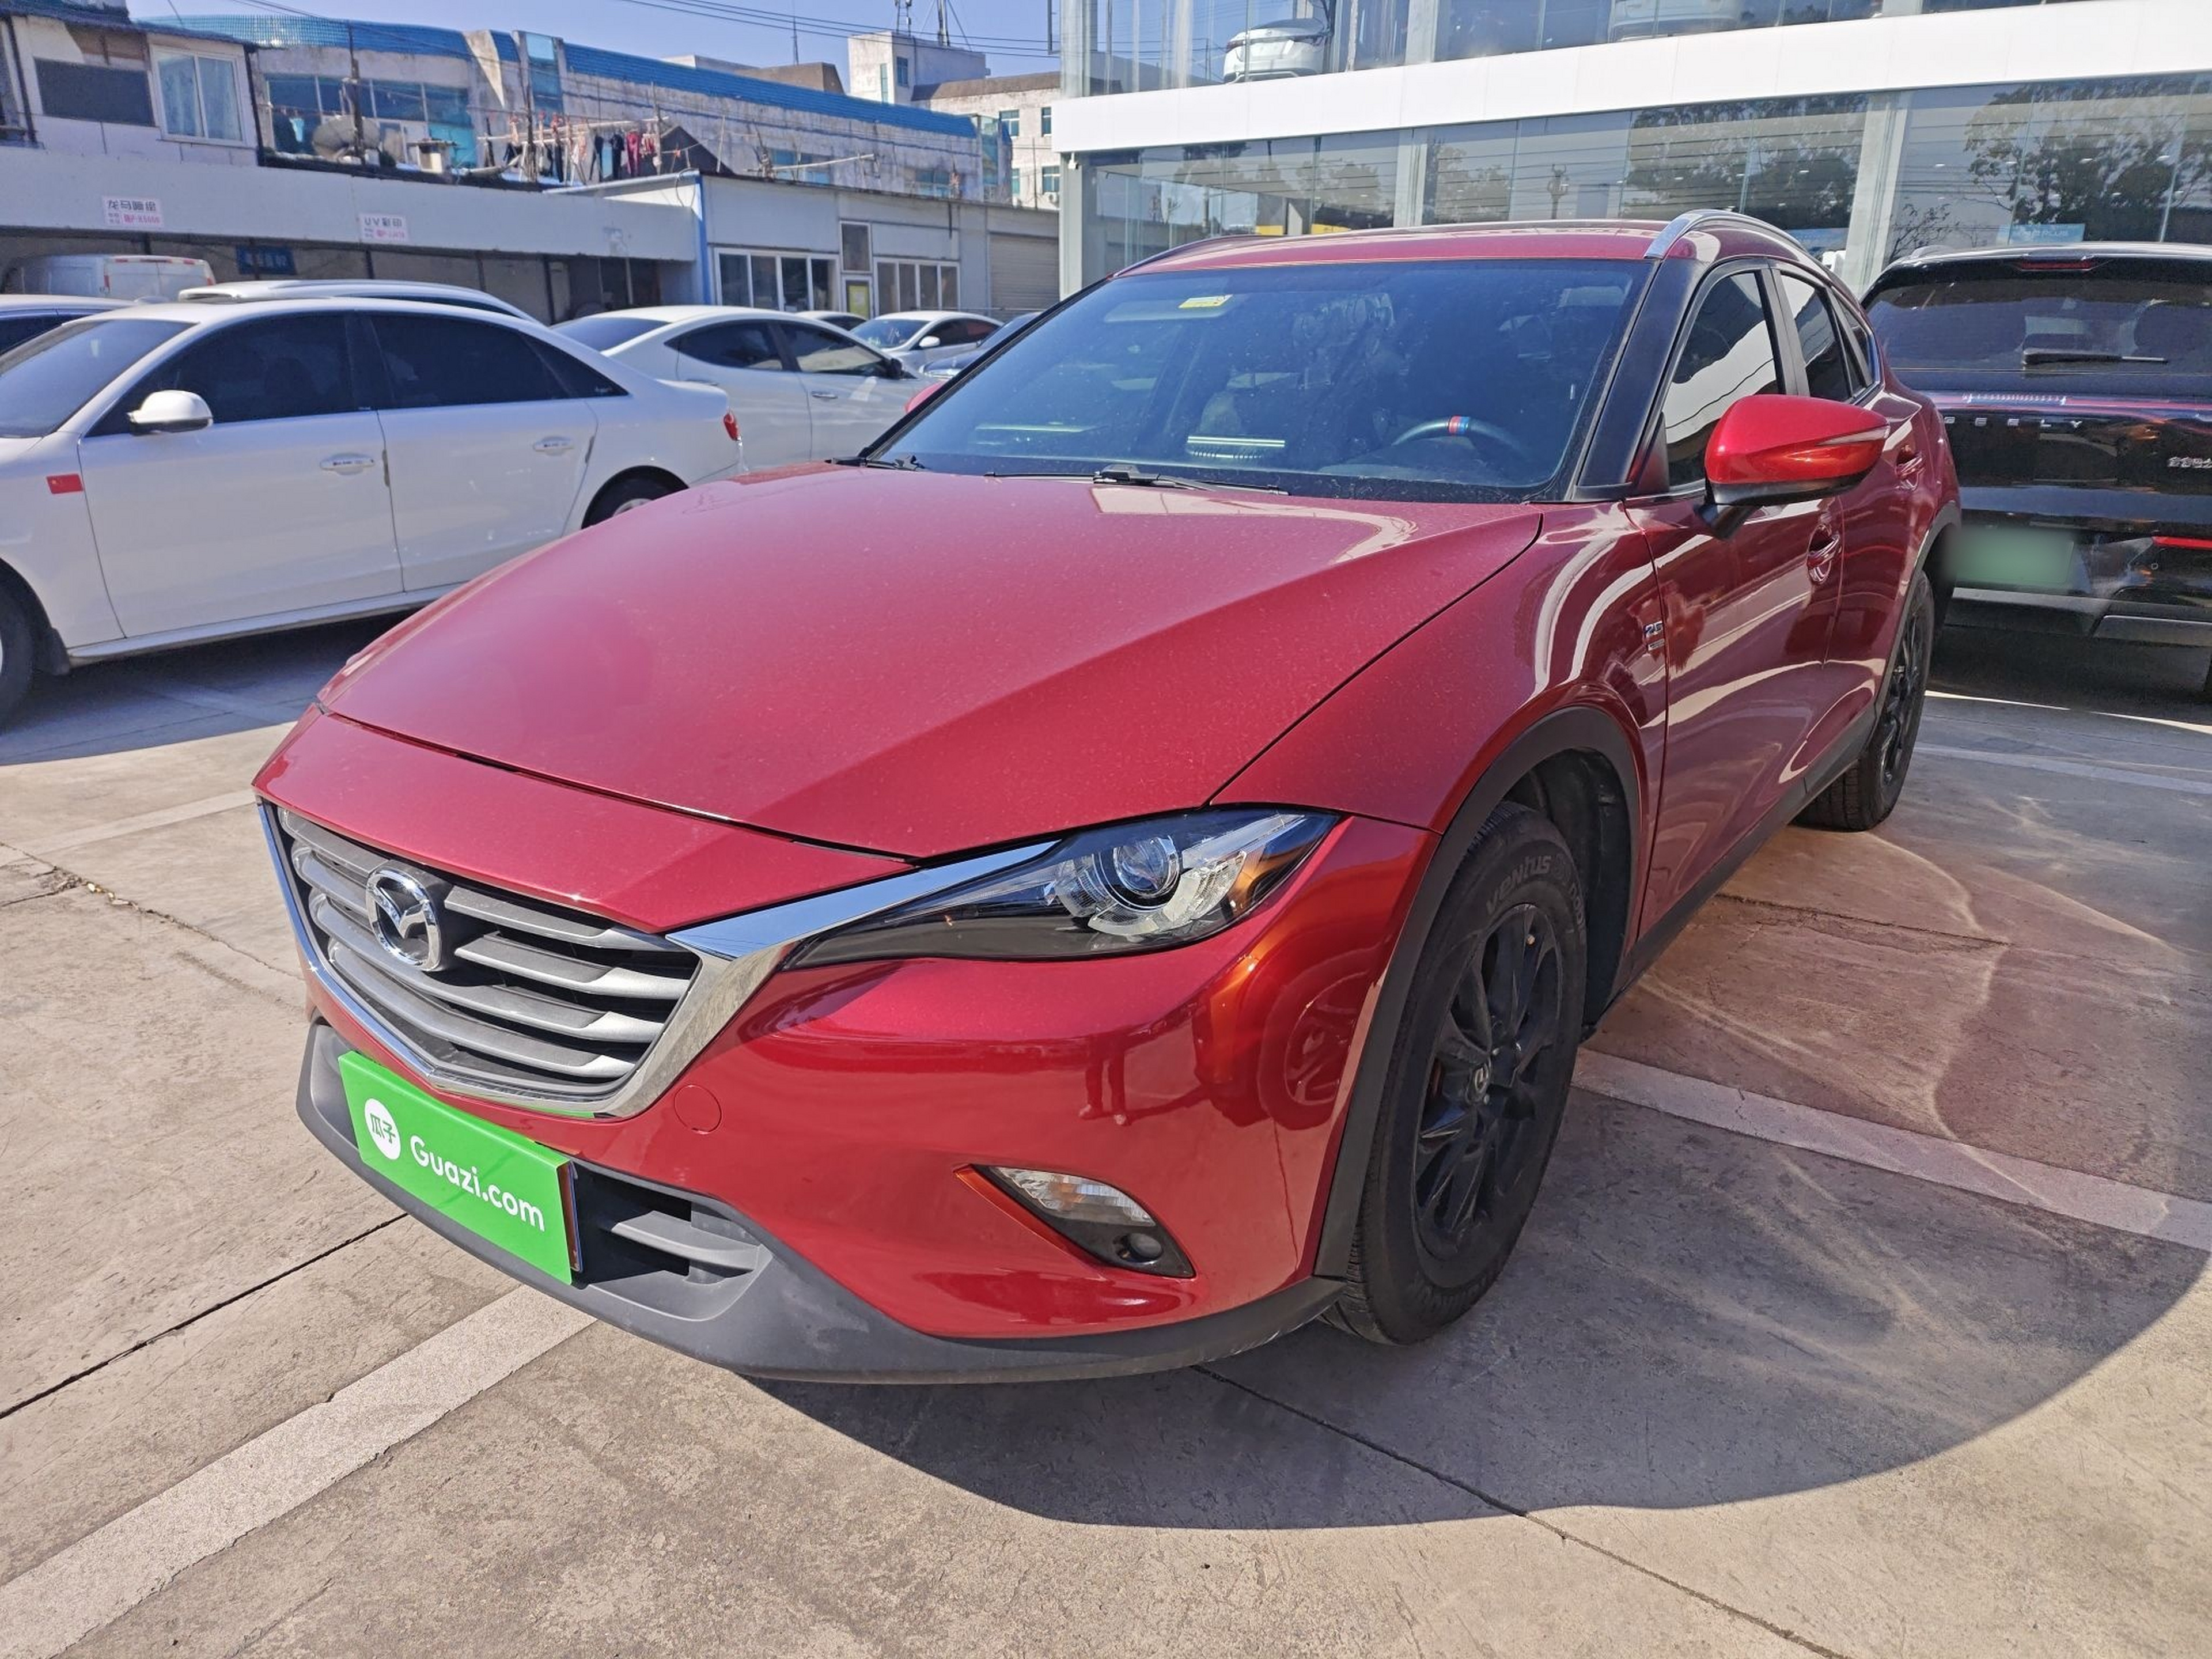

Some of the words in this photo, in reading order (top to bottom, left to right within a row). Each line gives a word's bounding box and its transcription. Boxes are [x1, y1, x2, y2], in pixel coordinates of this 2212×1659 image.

[1944, 416, 2083, 428] GEELY
[370, 1113, 396, 1144] 瓜子
[410, 1135, 545, 1232] Guazi.com
